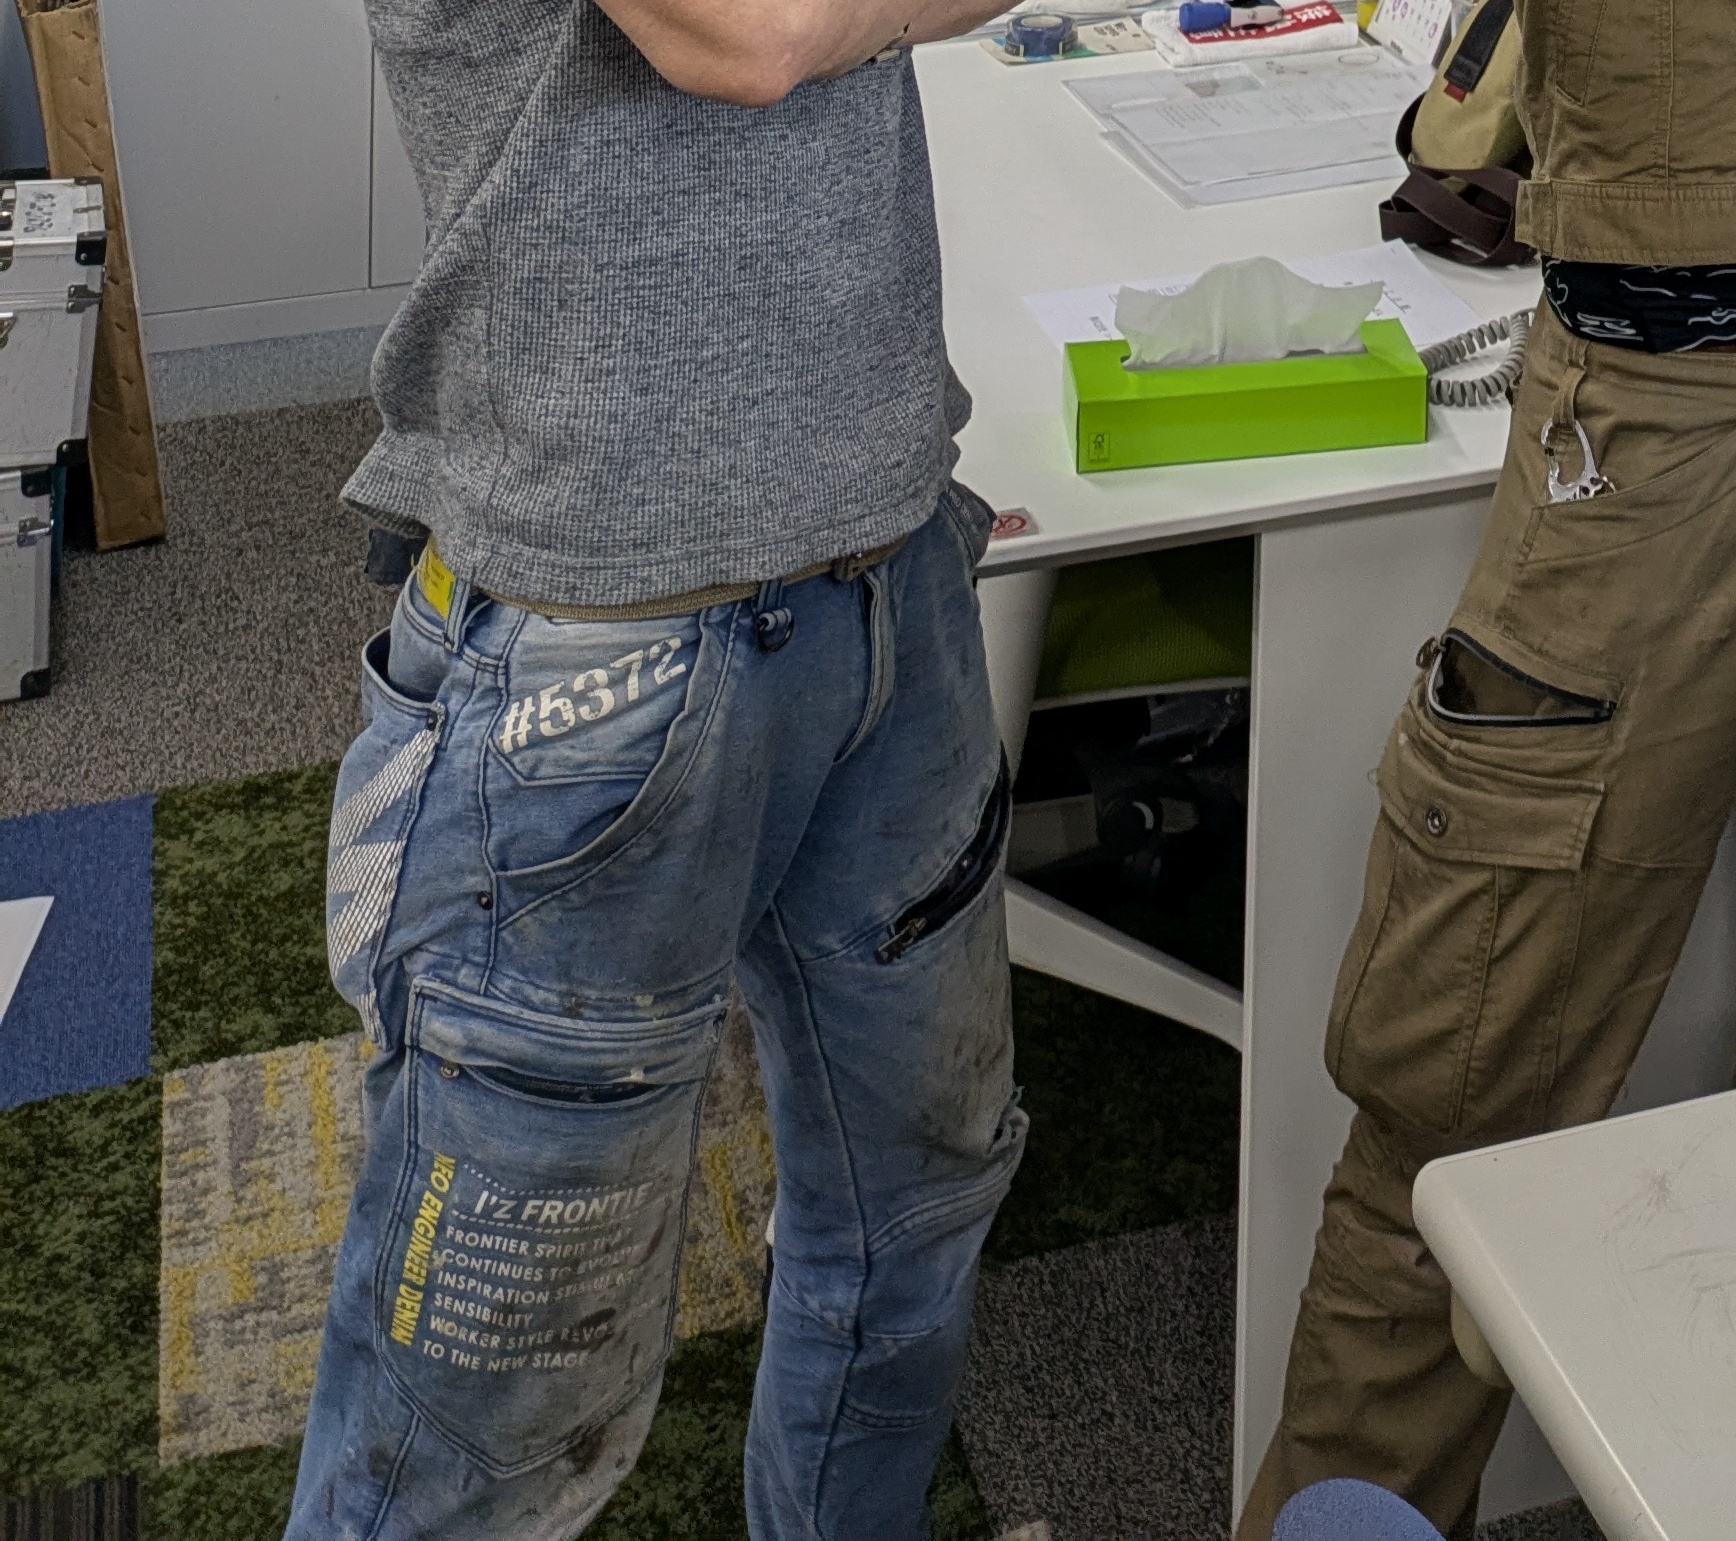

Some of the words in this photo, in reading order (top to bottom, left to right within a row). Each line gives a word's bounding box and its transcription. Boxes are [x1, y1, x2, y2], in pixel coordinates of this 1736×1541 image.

[499, 636, 687, 755] #5372
[430, 1152, 456, 1194] NEO
[521, 1182, 656, 1225] FRONTIE
[402, 1191, 444, 1286] ENGINEER
[446, 1226, 530, 1256] FRONTIER
[535, 1240, 586, 1258] SPIRIT
[441, 1248, 543, 1282] CONTINUES
[549, 1266, 573, 1281] TO
[436, 1271, 550, 1304] INSPIRATION
[390, 1279, 424, 1346] DENIM
[434, 1293, 534, 1328] SENSIBILITY
[430, 1314, 500, 1348] WORKER
[506, 1329, 560, 1350] STYLE
[422, 1340, 445, 1359] TO
[451, 1349, 481, 1371] THE
[487, 1356, 526, 1372] NEW
